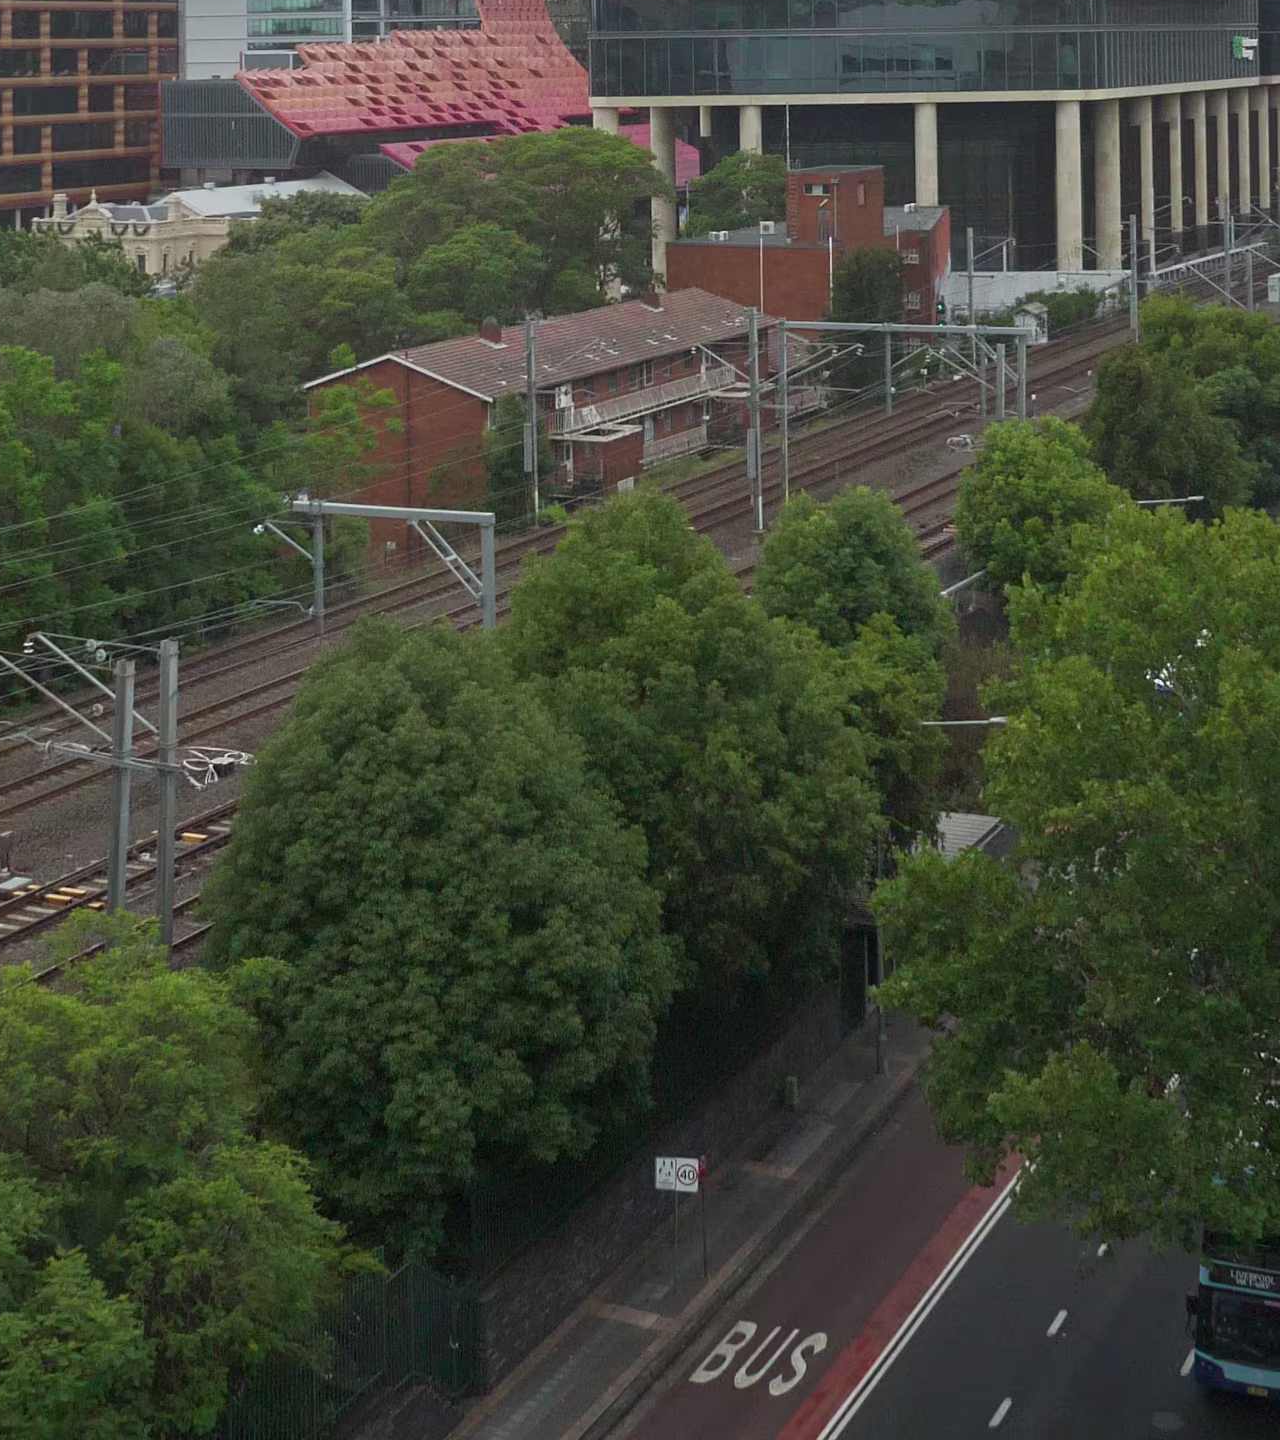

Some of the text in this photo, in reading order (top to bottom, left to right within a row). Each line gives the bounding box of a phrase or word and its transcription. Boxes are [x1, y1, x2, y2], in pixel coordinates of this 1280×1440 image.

[680, 1170, 695, 1181] 40
[1230, 1269, 1275, 1285] LIVERPOOL
[688, 1320, 828, 1396] BUS
